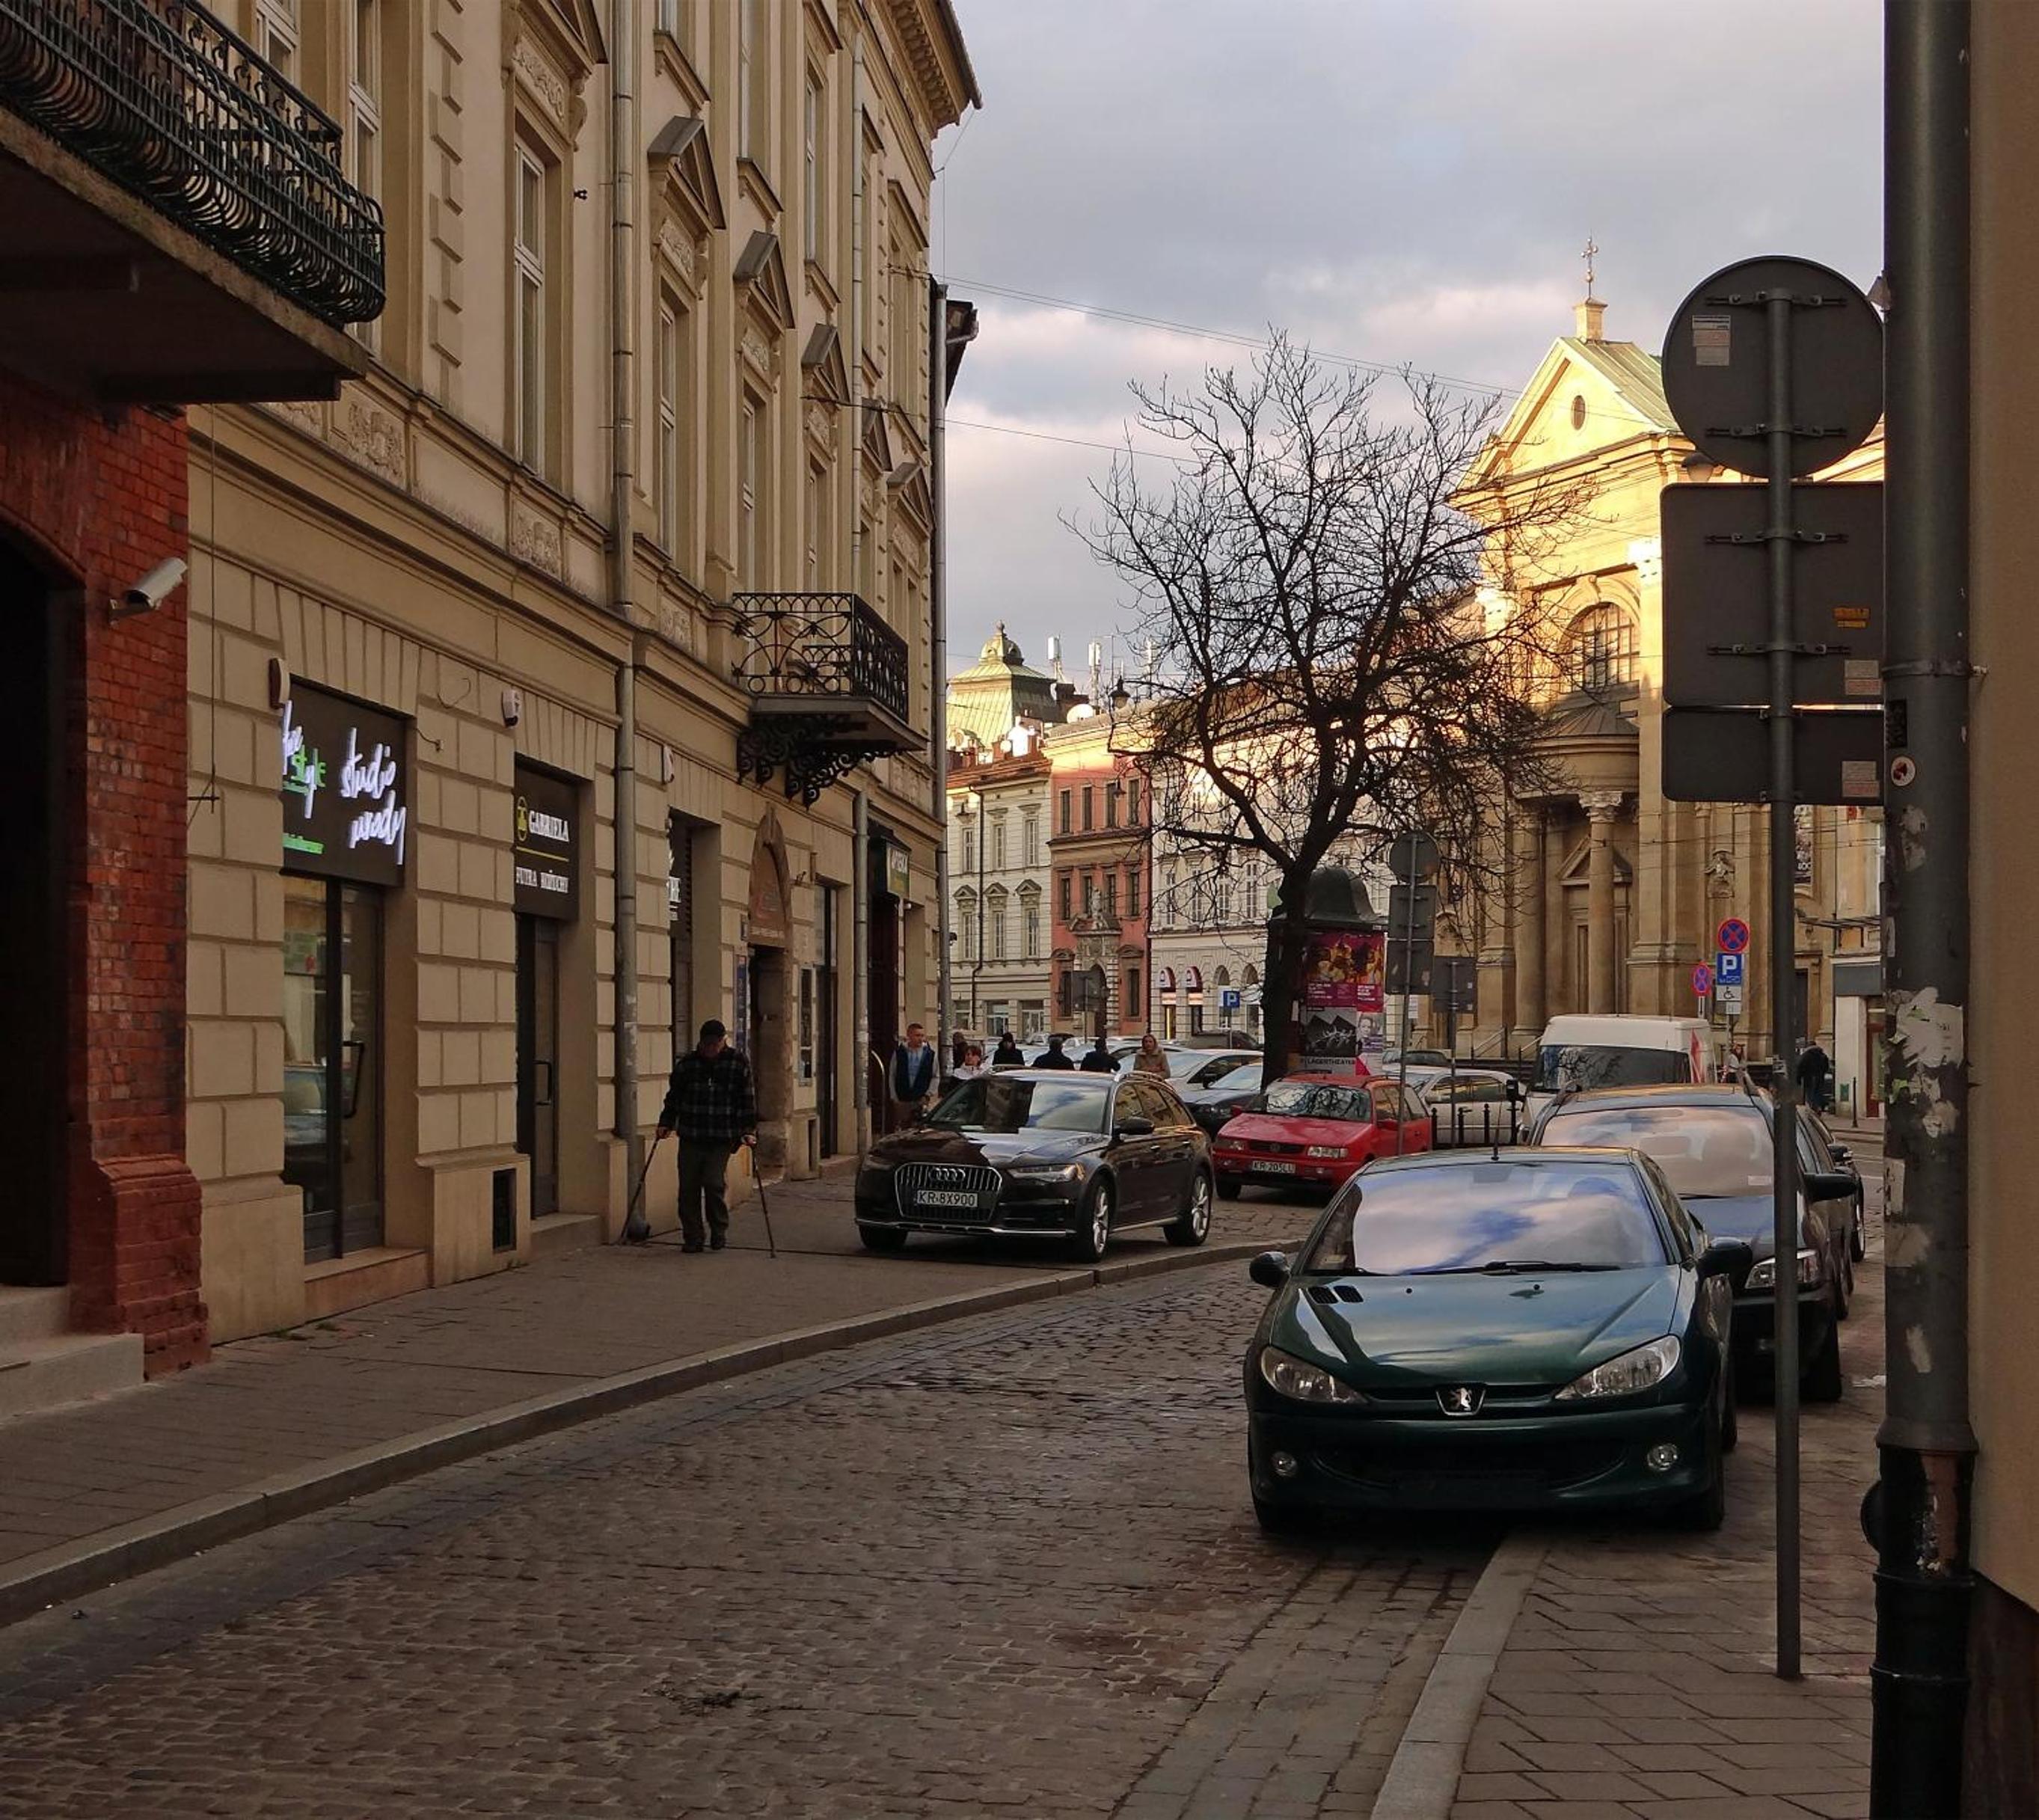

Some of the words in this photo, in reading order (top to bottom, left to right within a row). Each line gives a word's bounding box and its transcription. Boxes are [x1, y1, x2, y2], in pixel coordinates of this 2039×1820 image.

[340, 727, 396, 799] studio
[1723, 955, 1738, 975] P
[1227, 993, 1236, 1006] P
[919, 1191, 936, 1204] KR
